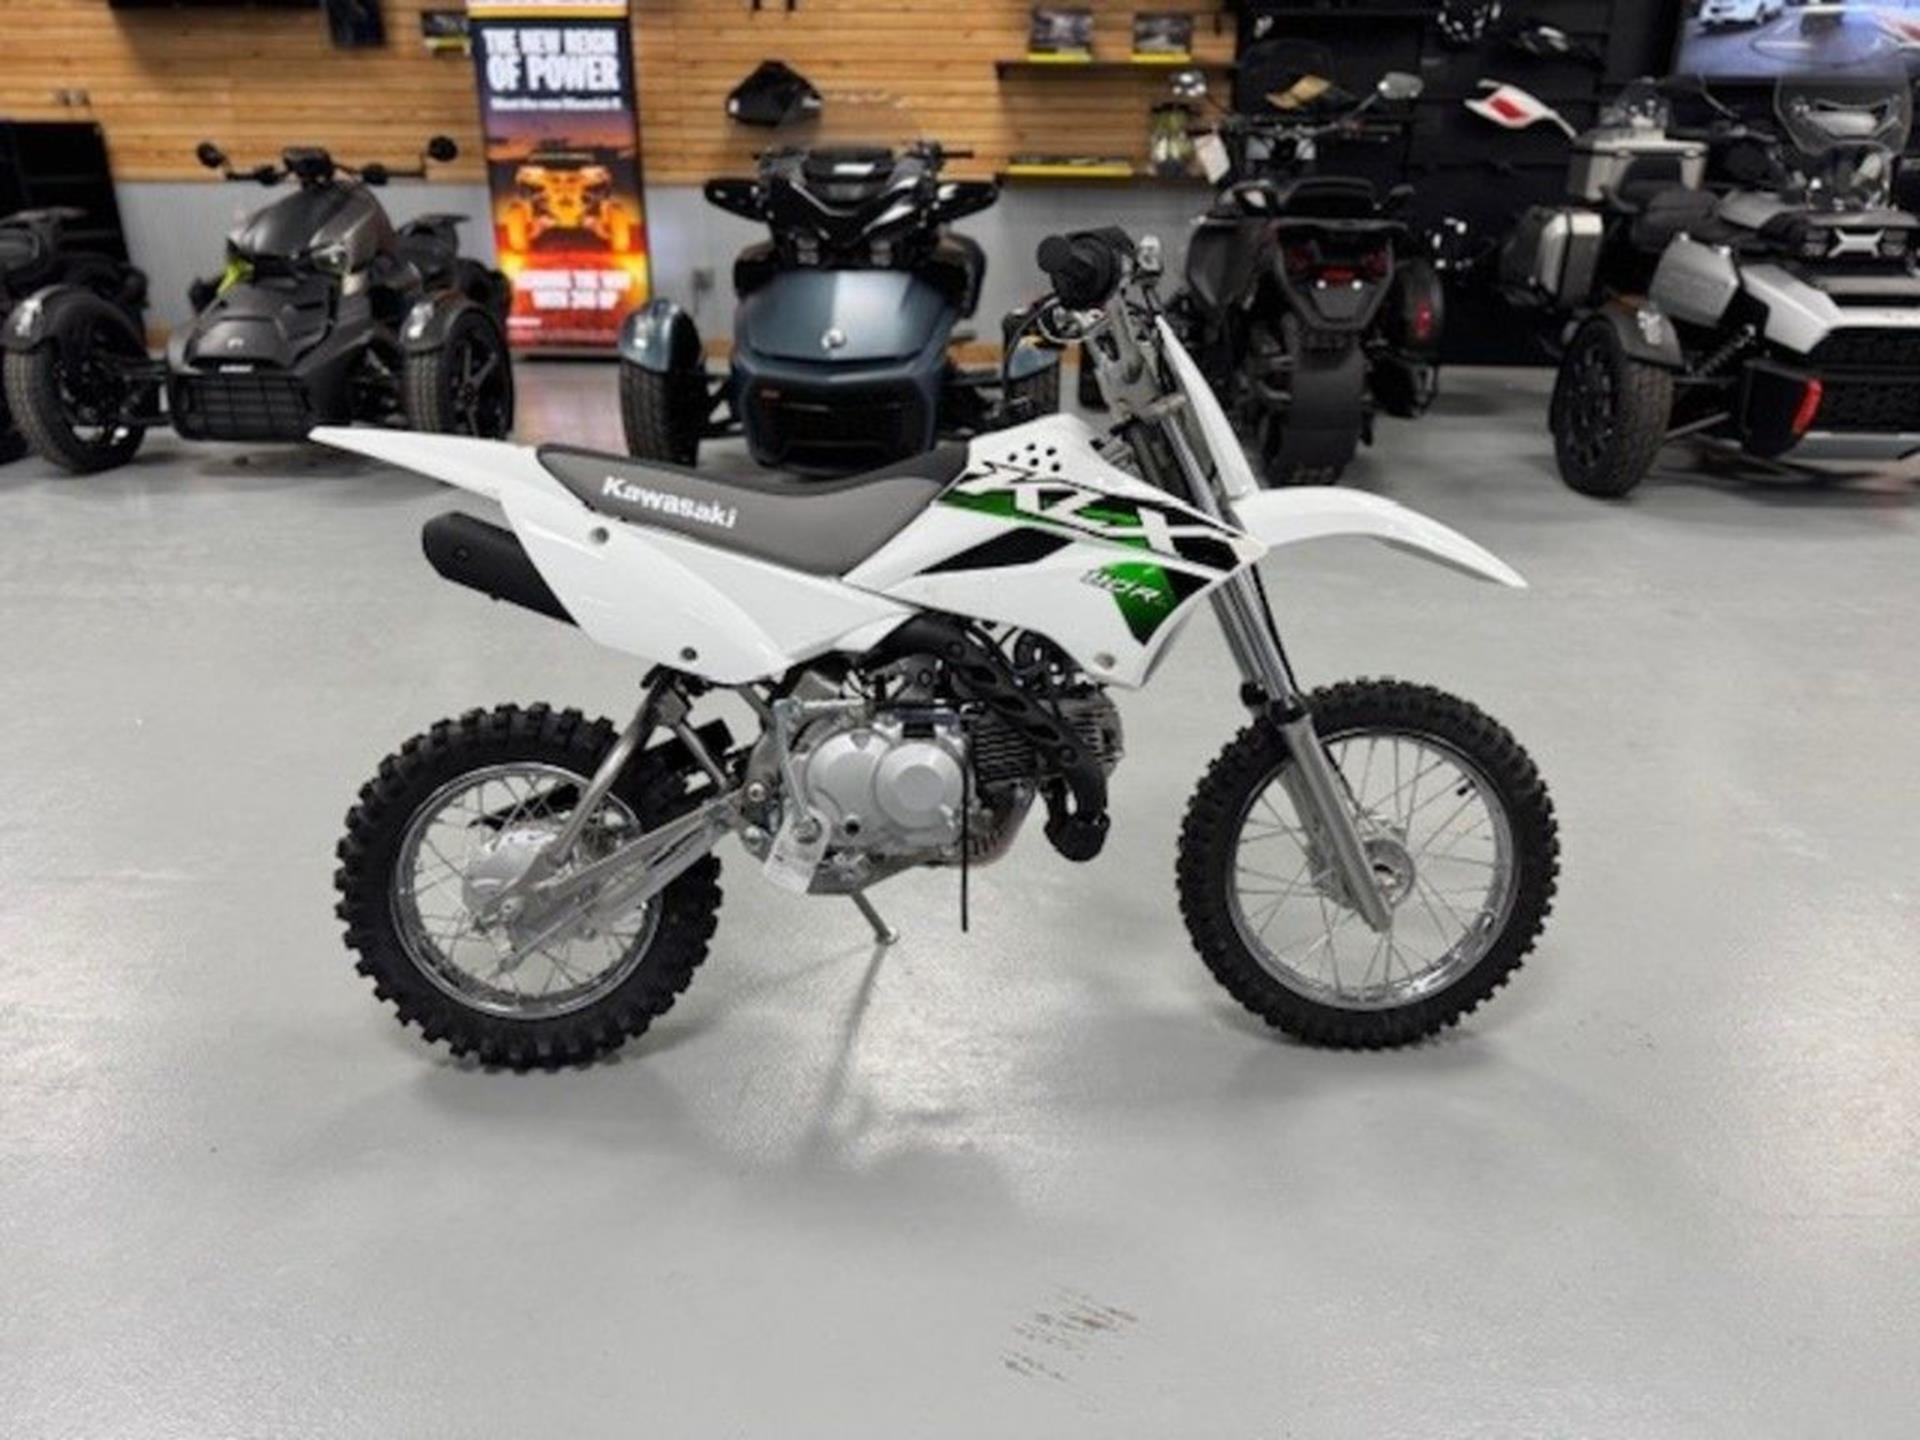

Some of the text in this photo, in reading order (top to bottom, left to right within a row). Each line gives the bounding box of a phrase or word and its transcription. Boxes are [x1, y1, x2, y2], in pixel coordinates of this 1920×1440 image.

[483, 29, 518, 53] THE
[520, 29, 560, 53] NEW
[488, 54, 619, 90] OF POWER
[602, 475, 738, 529] Kawasaki
